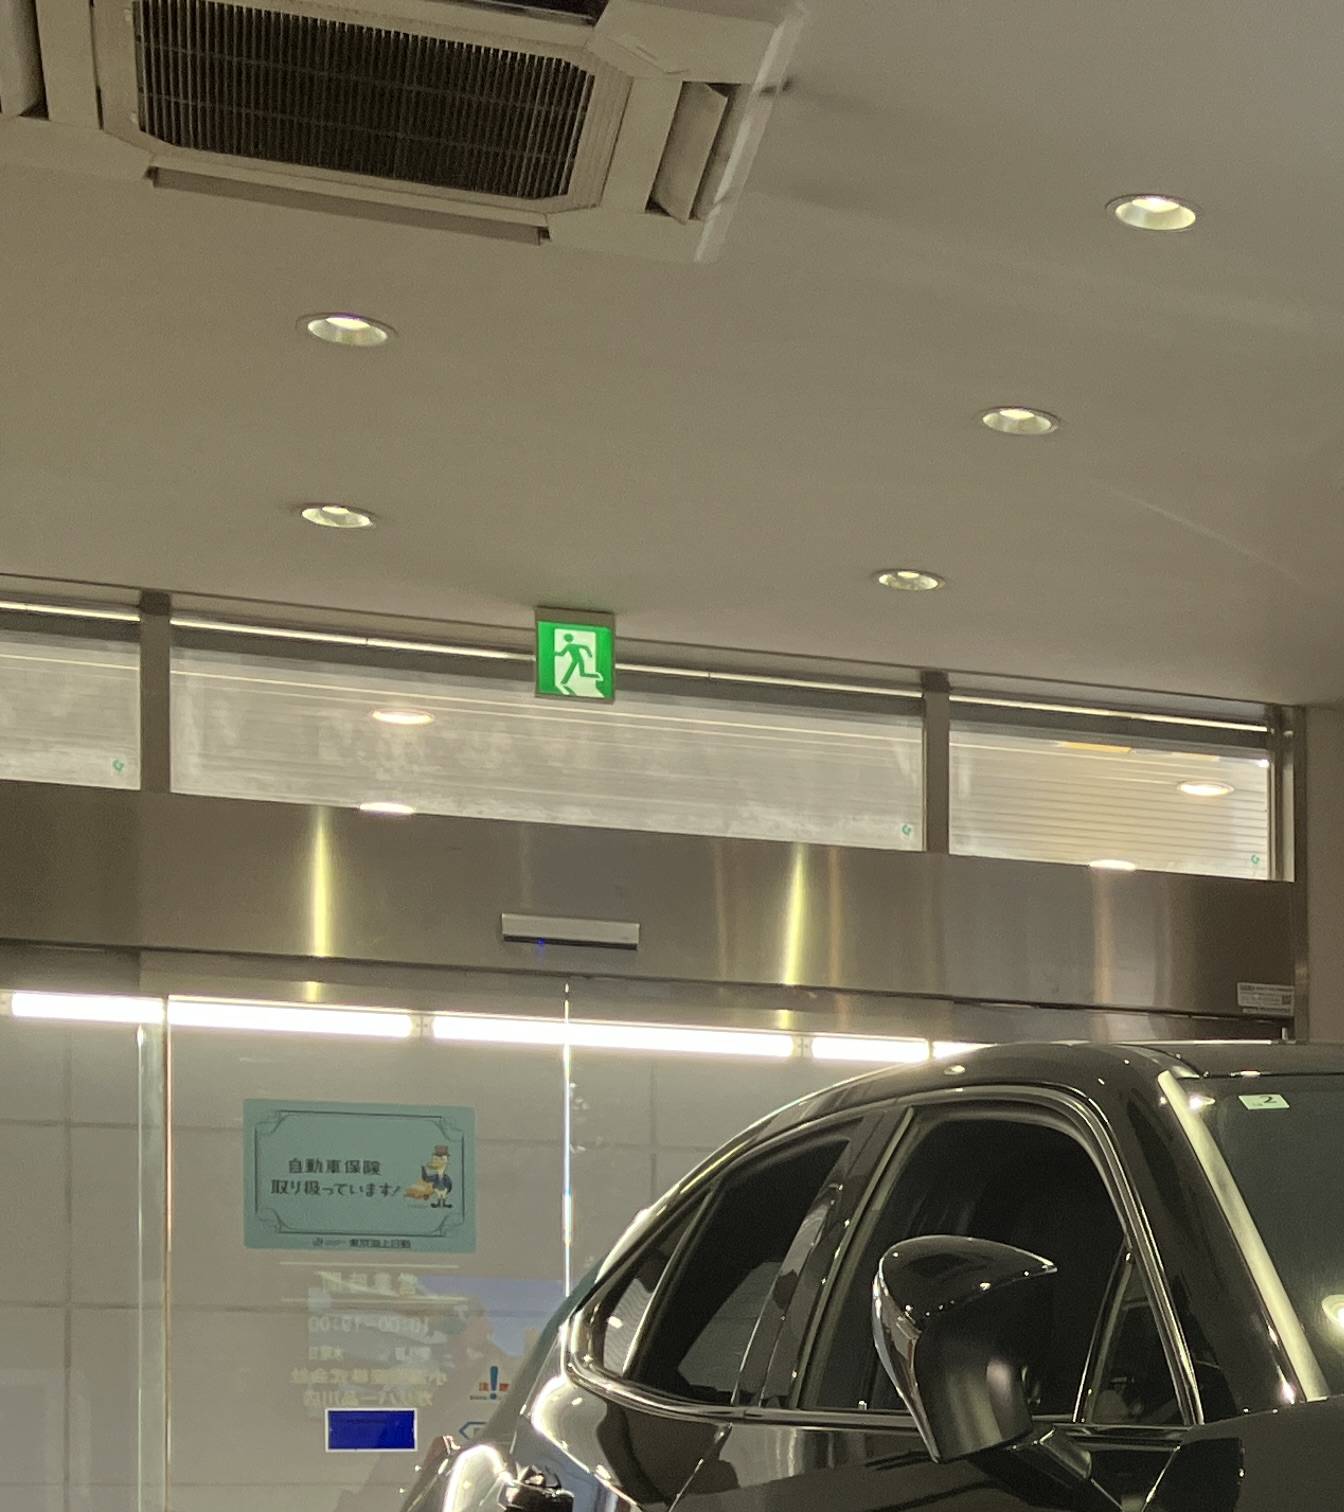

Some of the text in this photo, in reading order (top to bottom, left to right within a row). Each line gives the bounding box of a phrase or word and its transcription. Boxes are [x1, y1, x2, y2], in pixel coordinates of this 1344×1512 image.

[288, 1158, 382, 1176] 自動車保険
